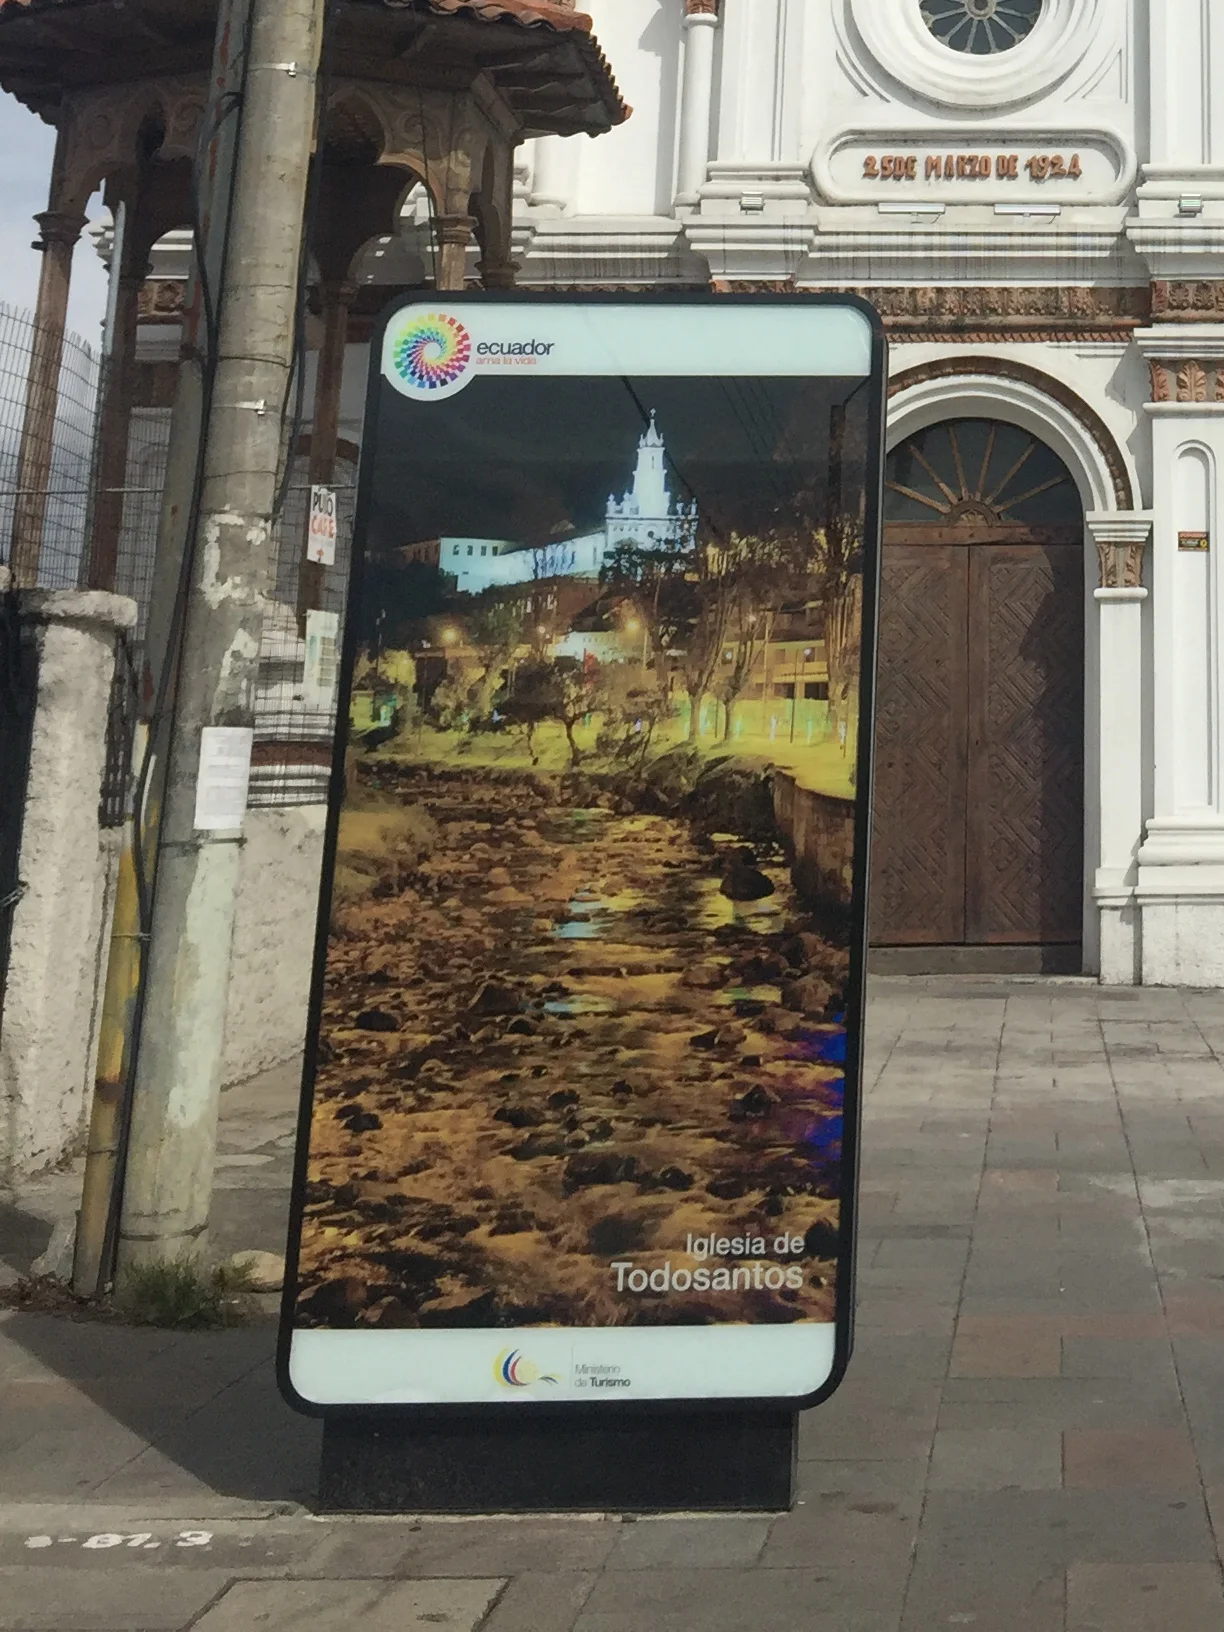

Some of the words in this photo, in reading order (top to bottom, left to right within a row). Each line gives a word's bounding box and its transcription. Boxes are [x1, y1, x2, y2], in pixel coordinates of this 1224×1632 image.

[925, 155, 991, 181] MARZO
[996, 154, 1018, 180] DE
[476, 338, 555, 355] ecuador
[686, 1232, 766, 1262] Iglesia
[773, 1231, 806, 1255] de
[611, 1260, 804, 1292] Todosantos
[589, 1376, 631, 1388] Turismo
